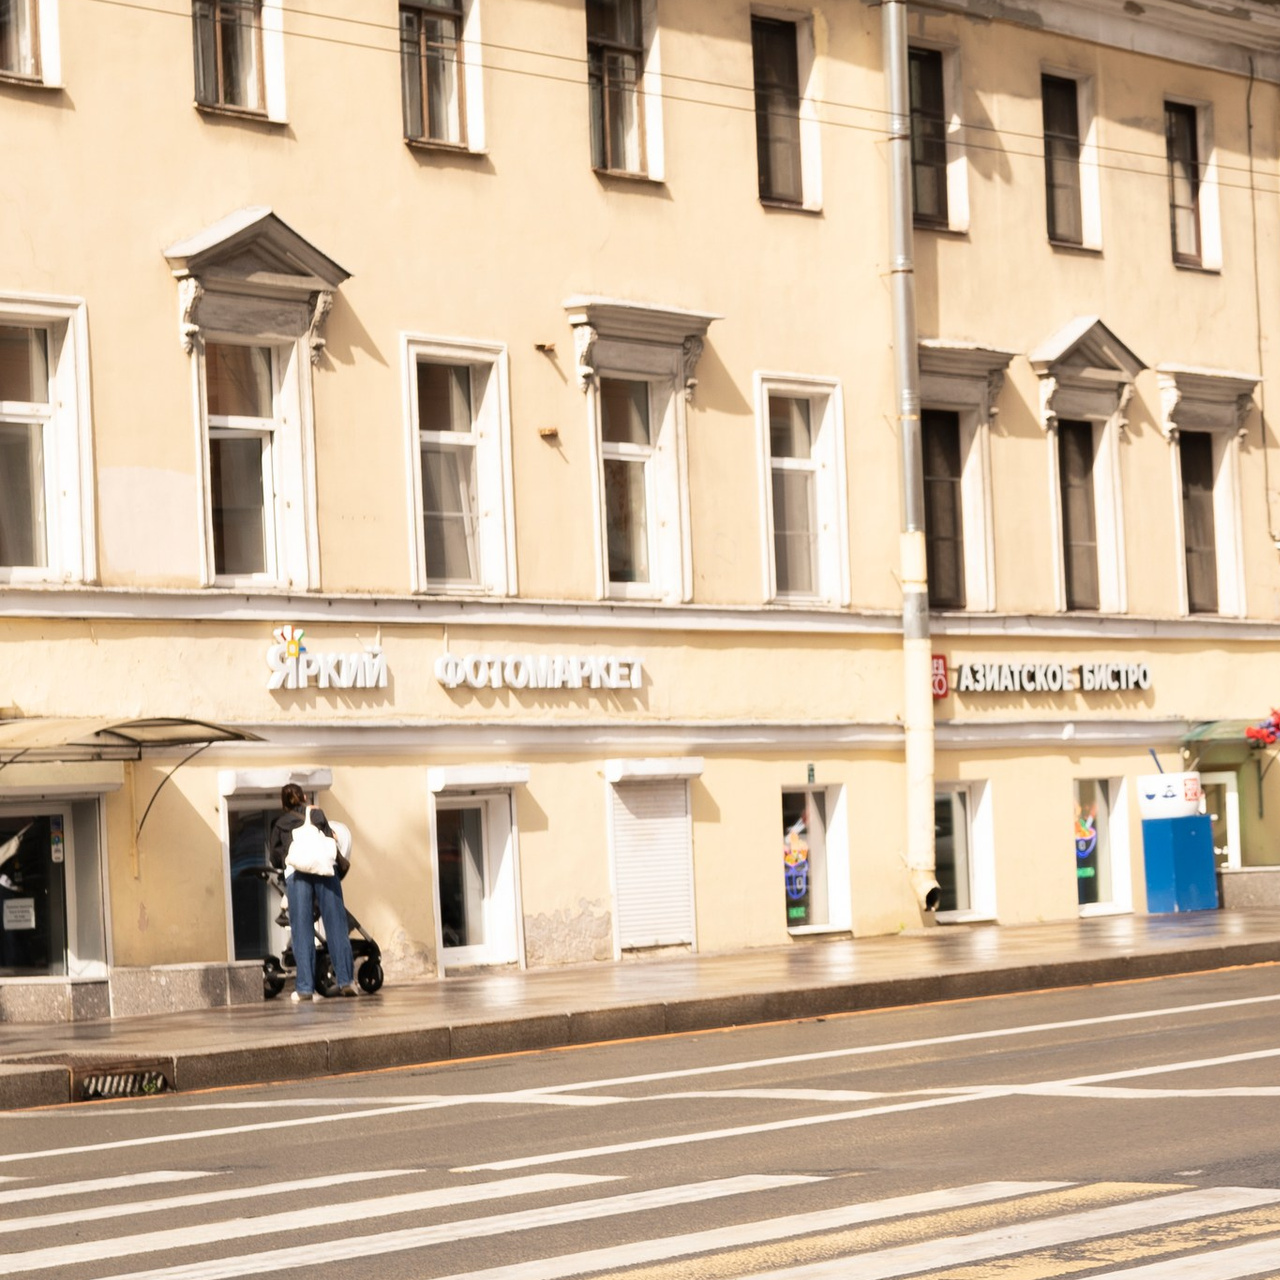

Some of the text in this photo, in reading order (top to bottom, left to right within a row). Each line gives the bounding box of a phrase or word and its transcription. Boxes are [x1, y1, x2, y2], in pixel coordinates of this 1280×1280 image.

[266, 644, 645, 689] ЯРКИЙ ФОТОМАРКЕТ
[959, 663, 1152, 692] АЗИАТСКОЕ БИСТРО
